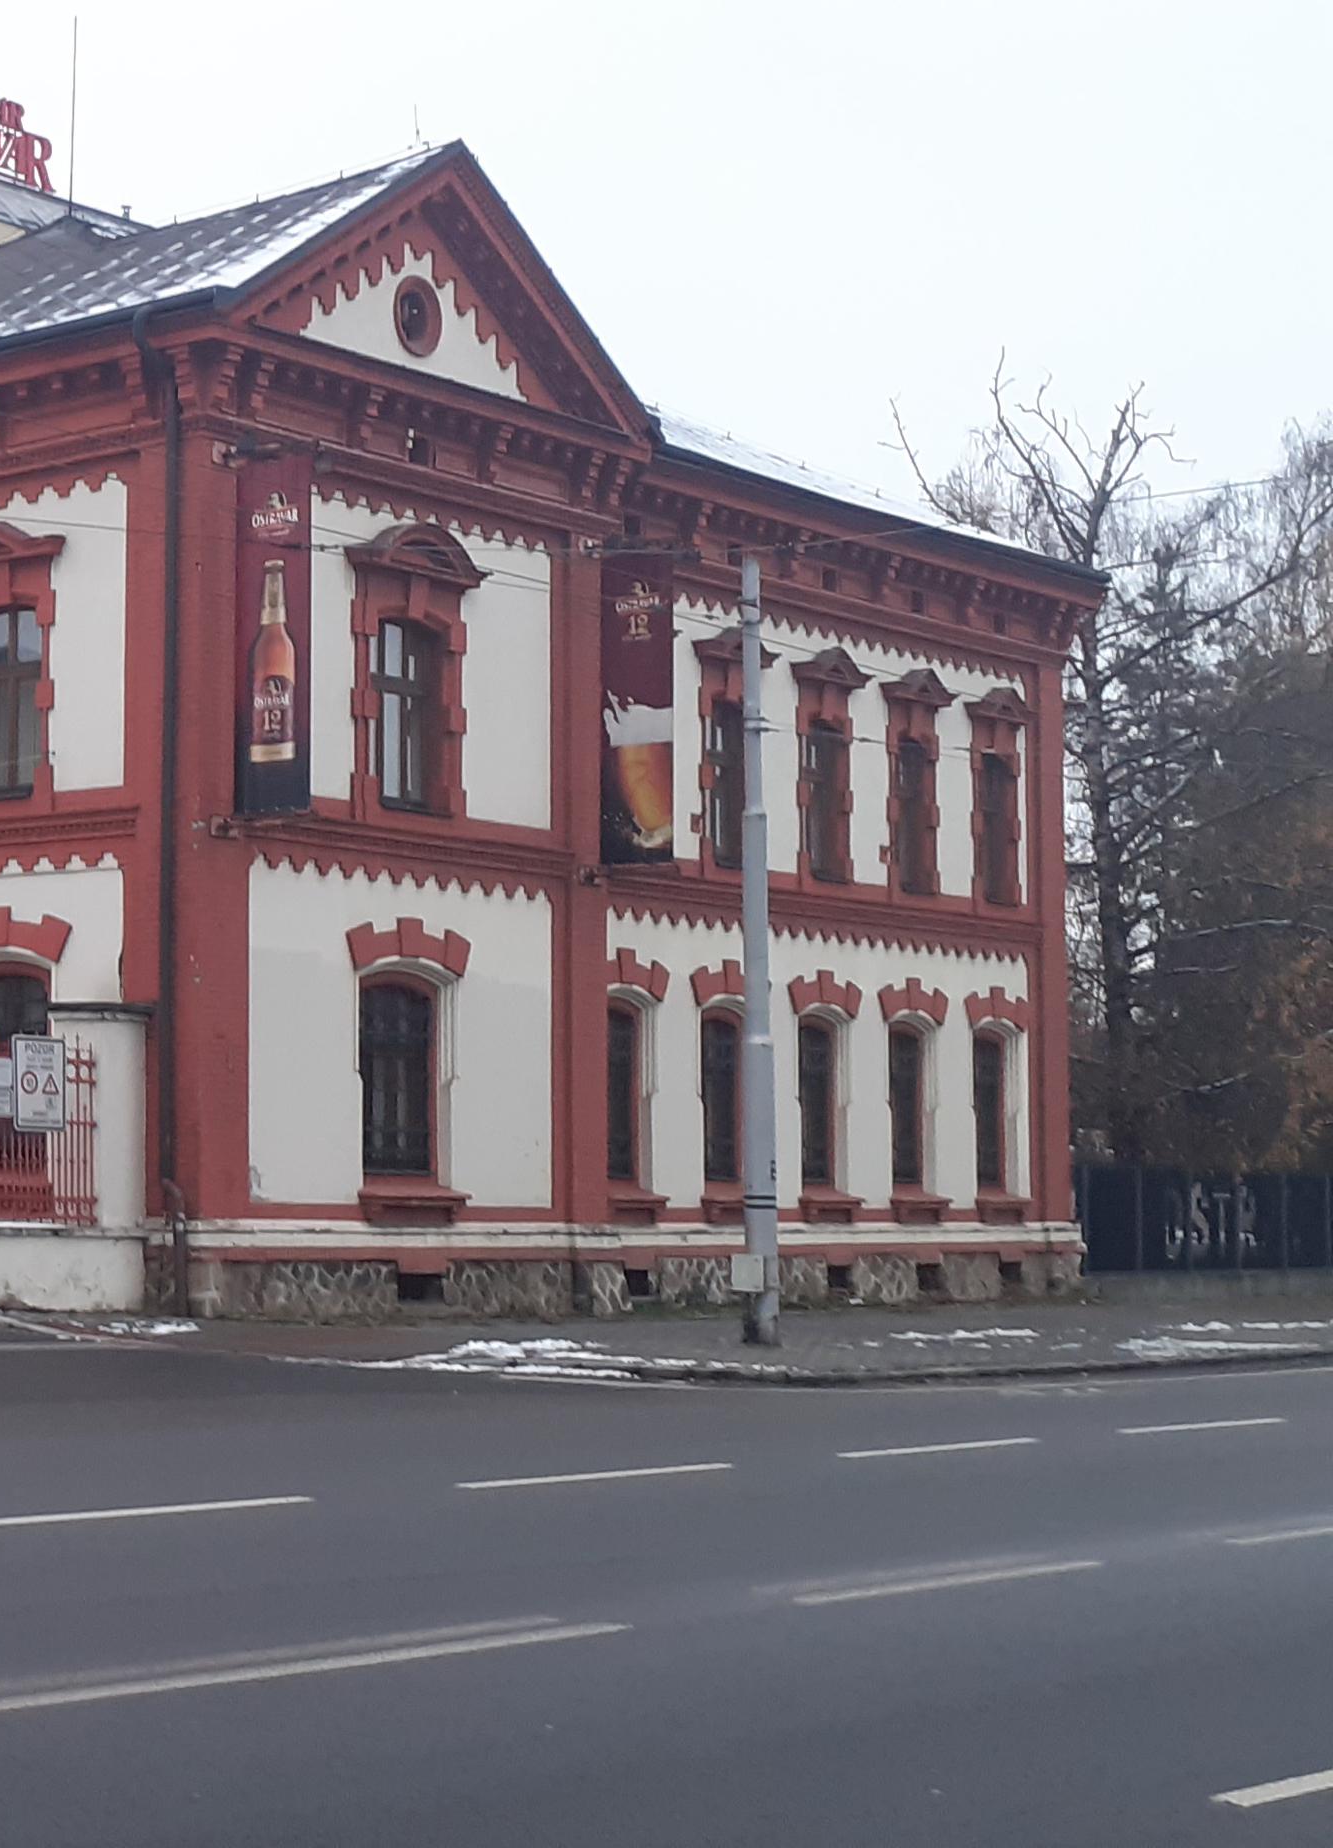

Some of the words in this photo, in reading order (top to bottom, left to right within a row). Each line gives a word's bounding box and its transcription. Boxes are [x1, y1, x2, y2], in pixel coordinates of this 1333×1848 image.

[251, 507, 299, 529] OSTRAVAR
[263, 709, 282, 731] 12
[24, 1041, 55, 1055] POZOR
